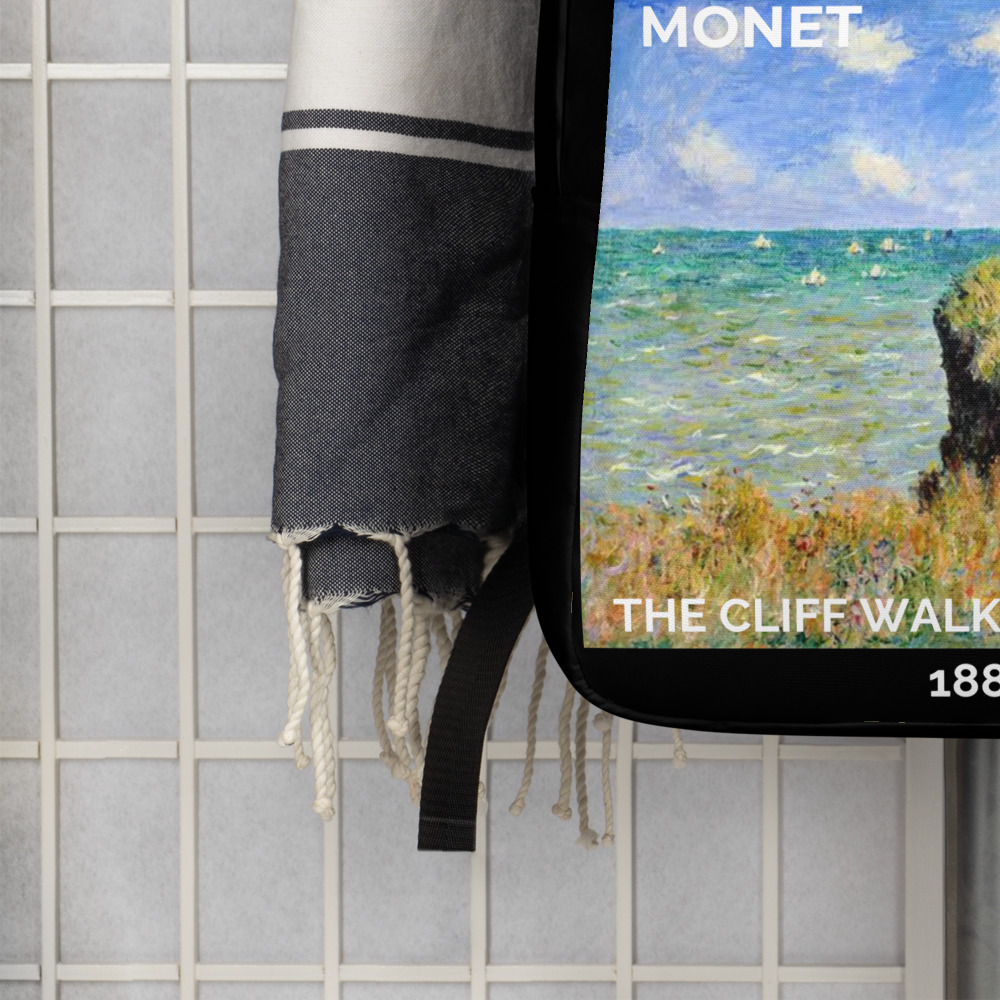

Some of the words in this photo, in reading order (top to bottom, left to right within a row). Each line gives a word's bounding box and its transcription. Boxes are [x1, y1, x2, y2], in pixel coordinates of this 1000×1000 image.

[642, 5, 863, 49] MONET
[613, 598, 706, 633] THE
[719, 597, 847, 633] CLIFF
[859, 598, 1000, 633] WALK
